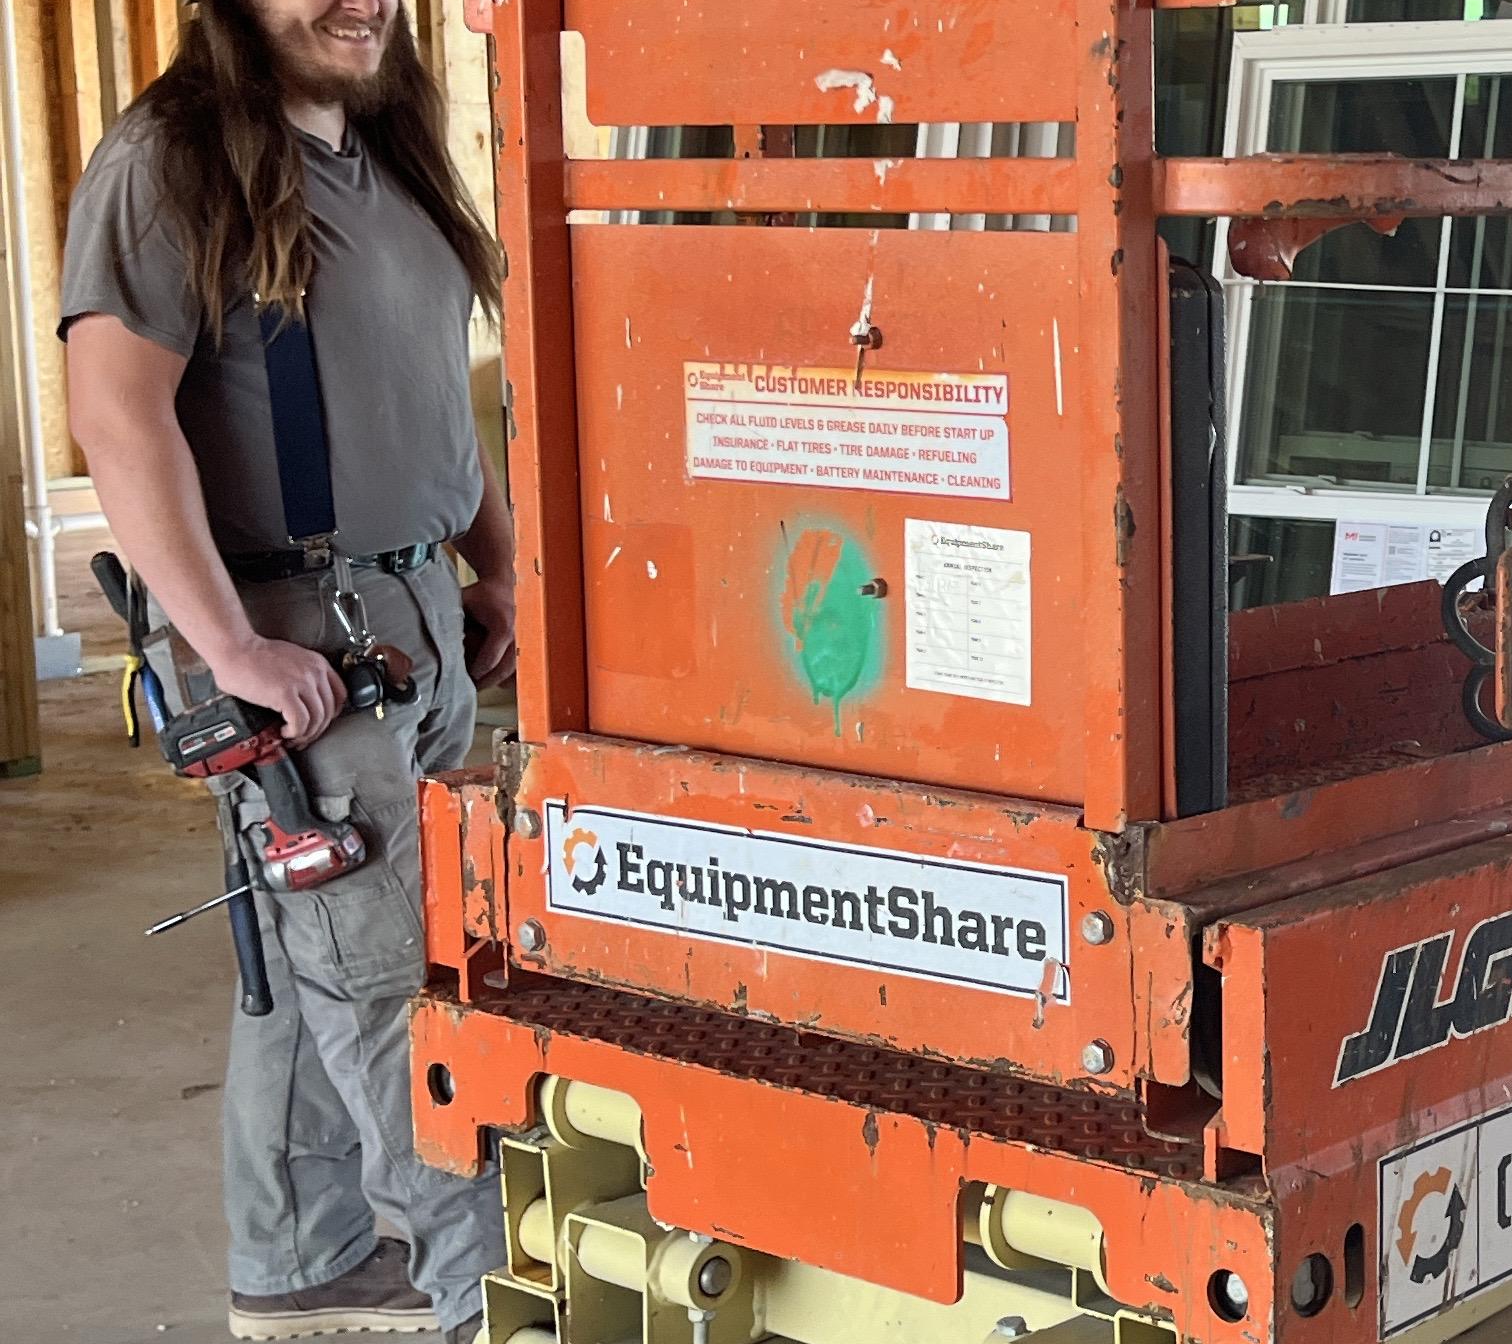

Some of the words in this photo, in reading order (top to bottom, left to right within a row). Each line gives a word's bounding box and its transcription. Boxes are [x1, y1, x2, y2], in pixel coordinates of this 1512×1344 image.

[755, 375, 847, 397] CUSTOMER
[852, 379, 1004, 404] RESPONSIBILITY
[696, 412, 727, 424] CHECK
[730, 414, 746, 426] ALL
[749, 415, 777, 428] FLUID
[780, 418, 814, 430] LEVELS
[817, 419, 824, 431] &
[827, 420, 866, 433] GREASE
[869, 422, 898, 435] DAILY
[901, 424, 941, 438] BEFORE
[944, 427, 977, 440] START
[980, 430, 995, 441] UP
[713, 436, 769, 450] INSURANCE
[777, 439, 798, 452] FLAT
[801, 441, 832, 454] TIRES
[840, 443, 863, 457] TIRE
[866, 445, 909, 460] DAMAGE
[918, 449, 977, 464] REFUELING
[693, 456, 733, 470] DAMAGE
[736, 460, 748, 471] TO
[750, 460, 808, 475] EQUIPMENT
[816, 465, 860, 479] BATTERY
[862, 468, 939, 485] MAINTENANCE
[947, 474, 1001, 490] CLEANING
[615, 841, 1047, 961] EquipmentShare
